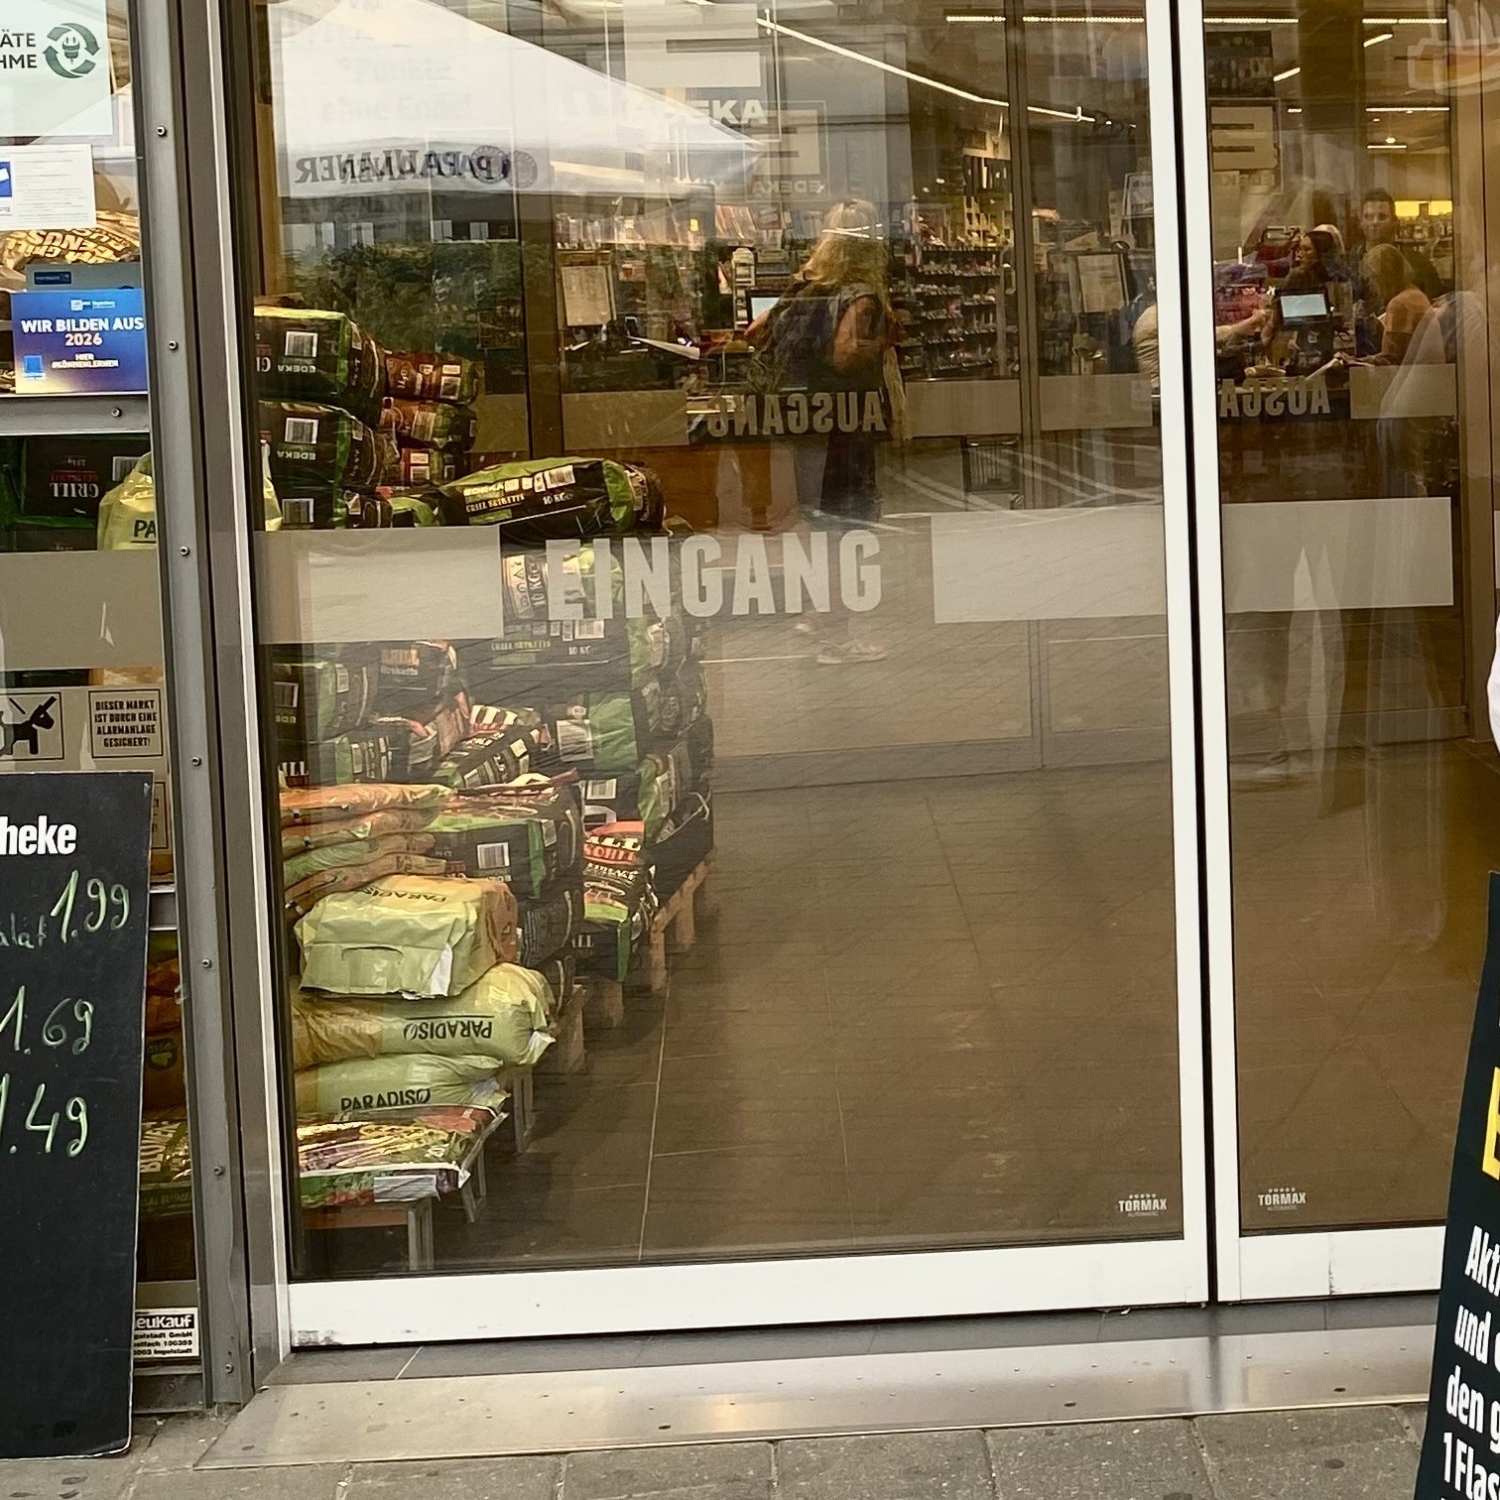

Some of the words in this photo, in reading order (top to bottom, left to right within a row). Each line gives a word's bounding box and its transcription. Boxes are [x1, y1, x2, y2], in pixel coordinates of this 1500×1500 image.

[21, 319, 53, 333] WIR
[56, 318, 109, 332] BILDEN
[112, 317, 144, 331] AUS
[65, 333, 103, 346] 2026
[51, 482, 99, 498] GRILL
[546, 529, 881, 620] EINGANG
[95, 700, 124, 711] DIESER
[126, 700, 155, 710] MARKT
[94, 713, 107, 723] IST
[109, 713, 136, 723] DURCH
[138, 712, 157, 722] EINE
[97, 724, 156, 735] ALARMANLAGE
[0, 815, 77, 855] heke
[50, 869, 130, 944] 1.99
[403, 1020, 493, 1040] PARADISO
[341, 1088, 431, 1111] PARADISO
[1118, 1198, 1167, 1212] TORMAX
[1258, 1192, 1307, 1206] TORMAX
[1454, 1304, 1492, 1364] und
[1446, 1364, 1485, 1434] den
[1443, 1432, 1453, 1483] 1
